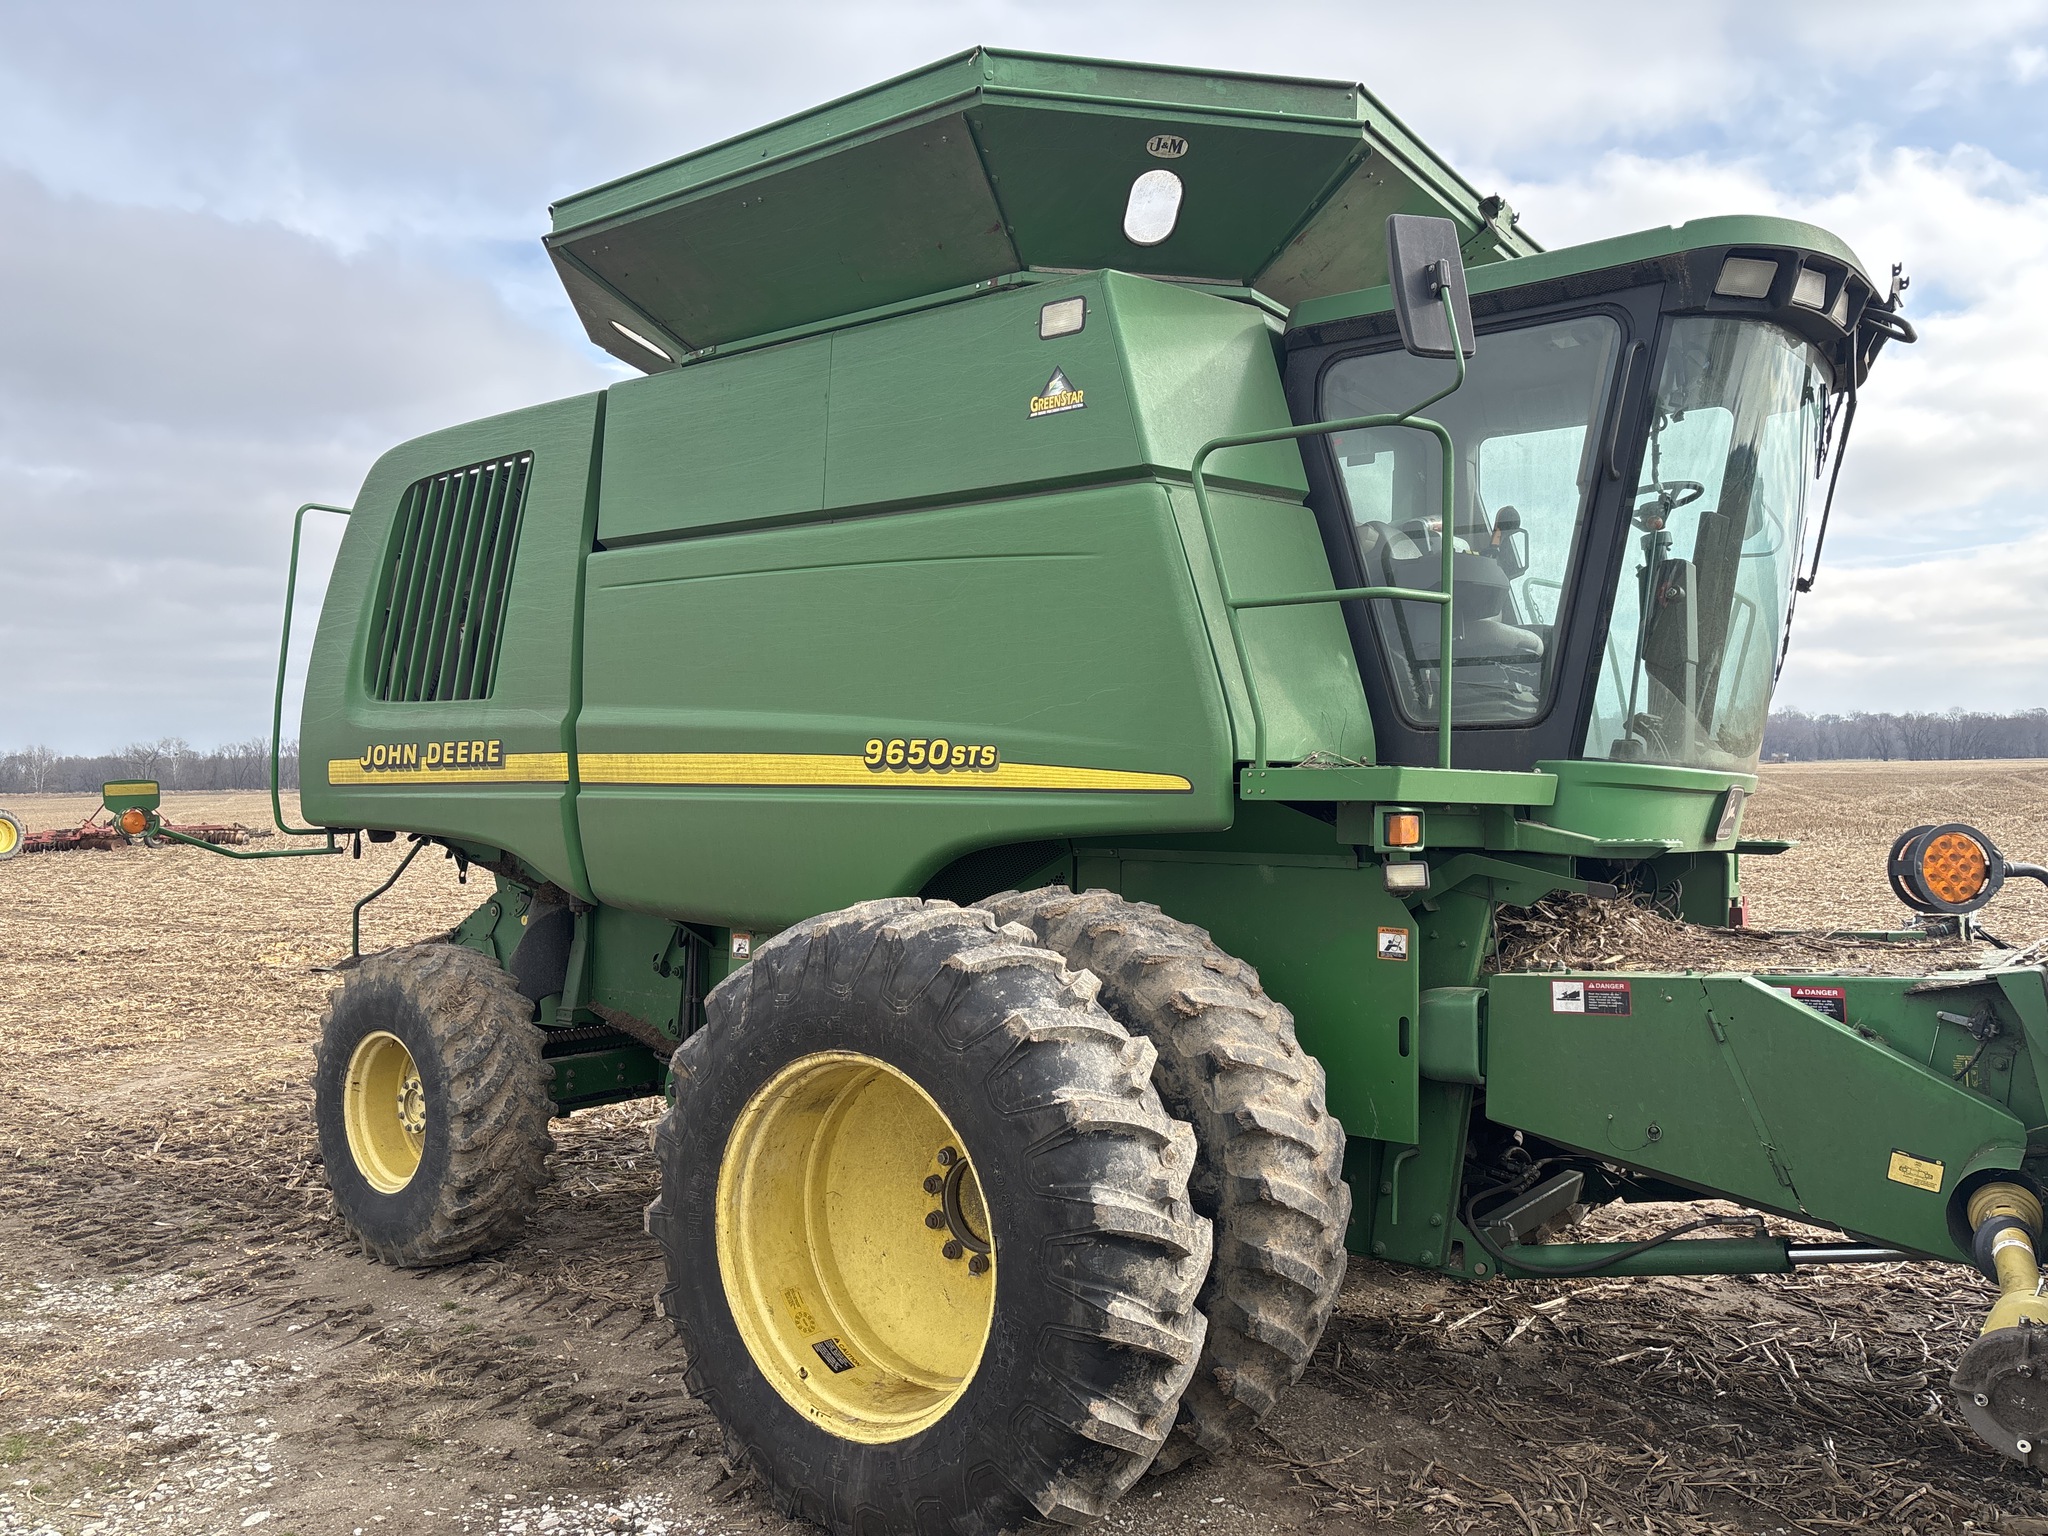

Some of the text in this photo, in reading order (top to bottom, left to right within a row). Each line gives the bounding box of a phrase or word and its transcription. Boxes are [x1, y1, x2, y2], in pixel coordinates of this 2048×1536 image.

[1150, 137, 1184, 154] J&M
[360, 739, 503, 770] JOHN DEERE
[839, 1343, 860, 1366] CAUTION
